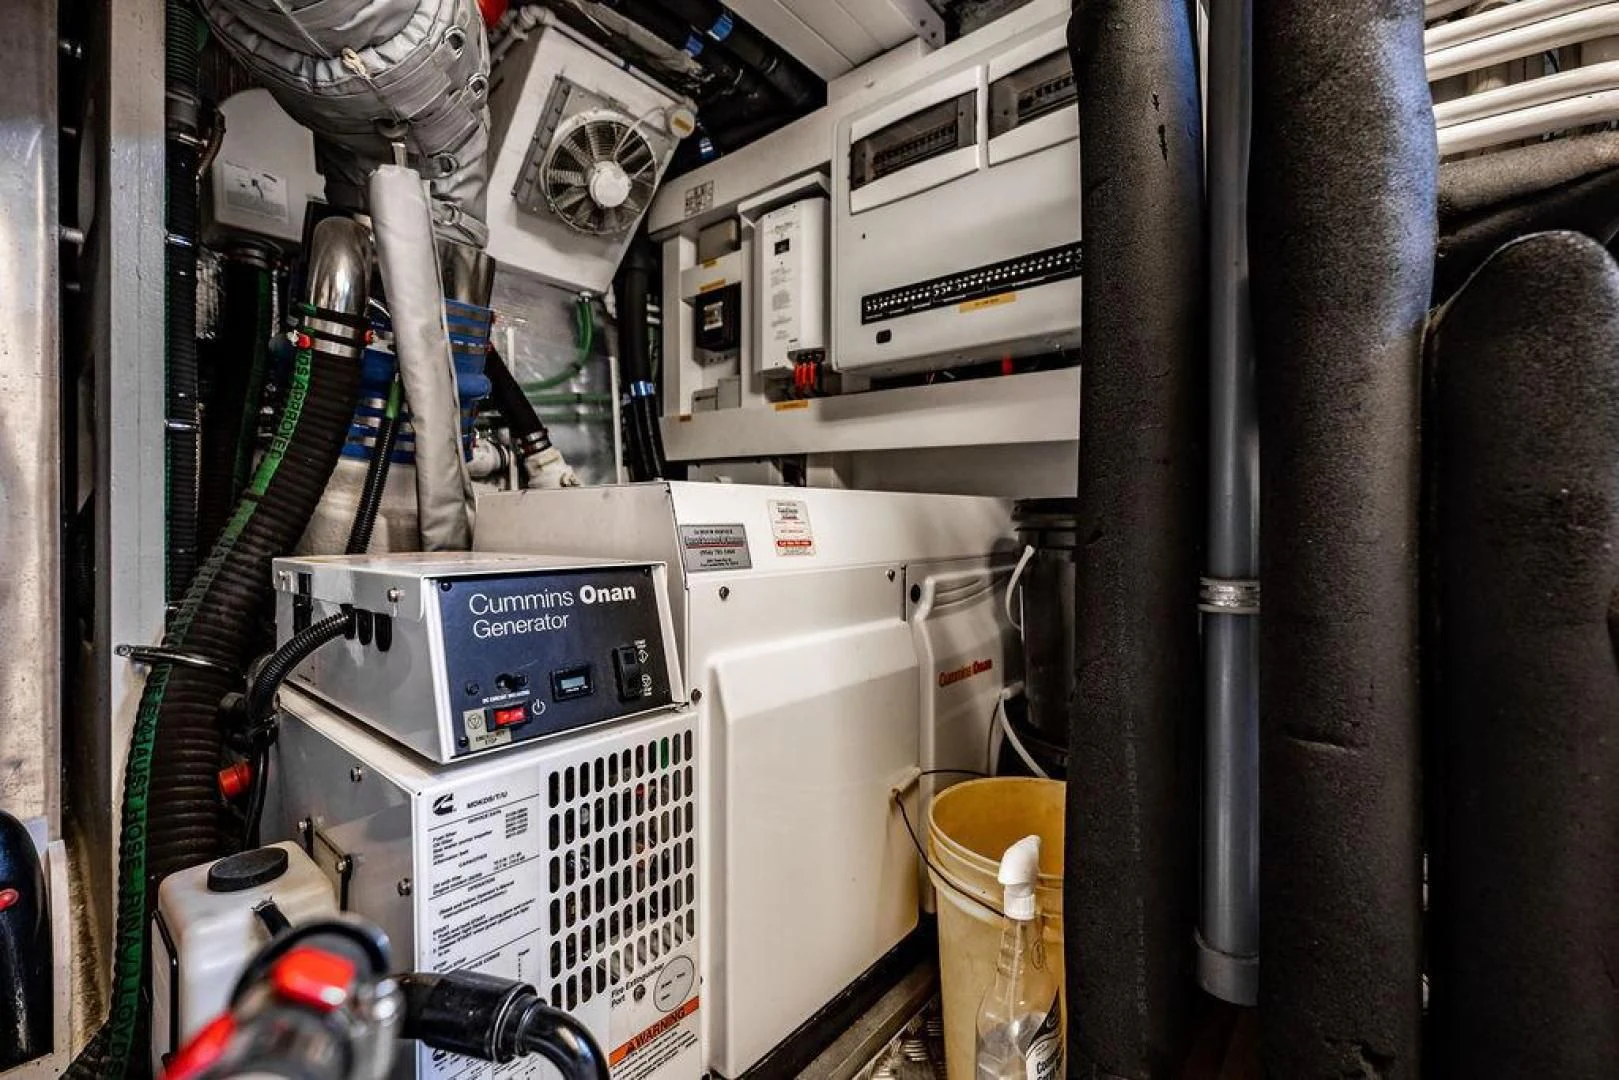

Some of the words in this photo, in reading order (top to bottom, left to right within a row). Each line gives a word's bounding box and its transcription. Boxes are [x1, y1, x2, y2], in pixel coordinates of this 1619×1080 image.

[271, 379, 309, 460] APPROVED
[469, 588, 574, 615] Cummins
[579, 584, 637, 605] Onan
[473, 613, 570, 639] Generator
[126, 808, 146, 870] HOSE
[637, 1007, 686, 1049] WARNING
